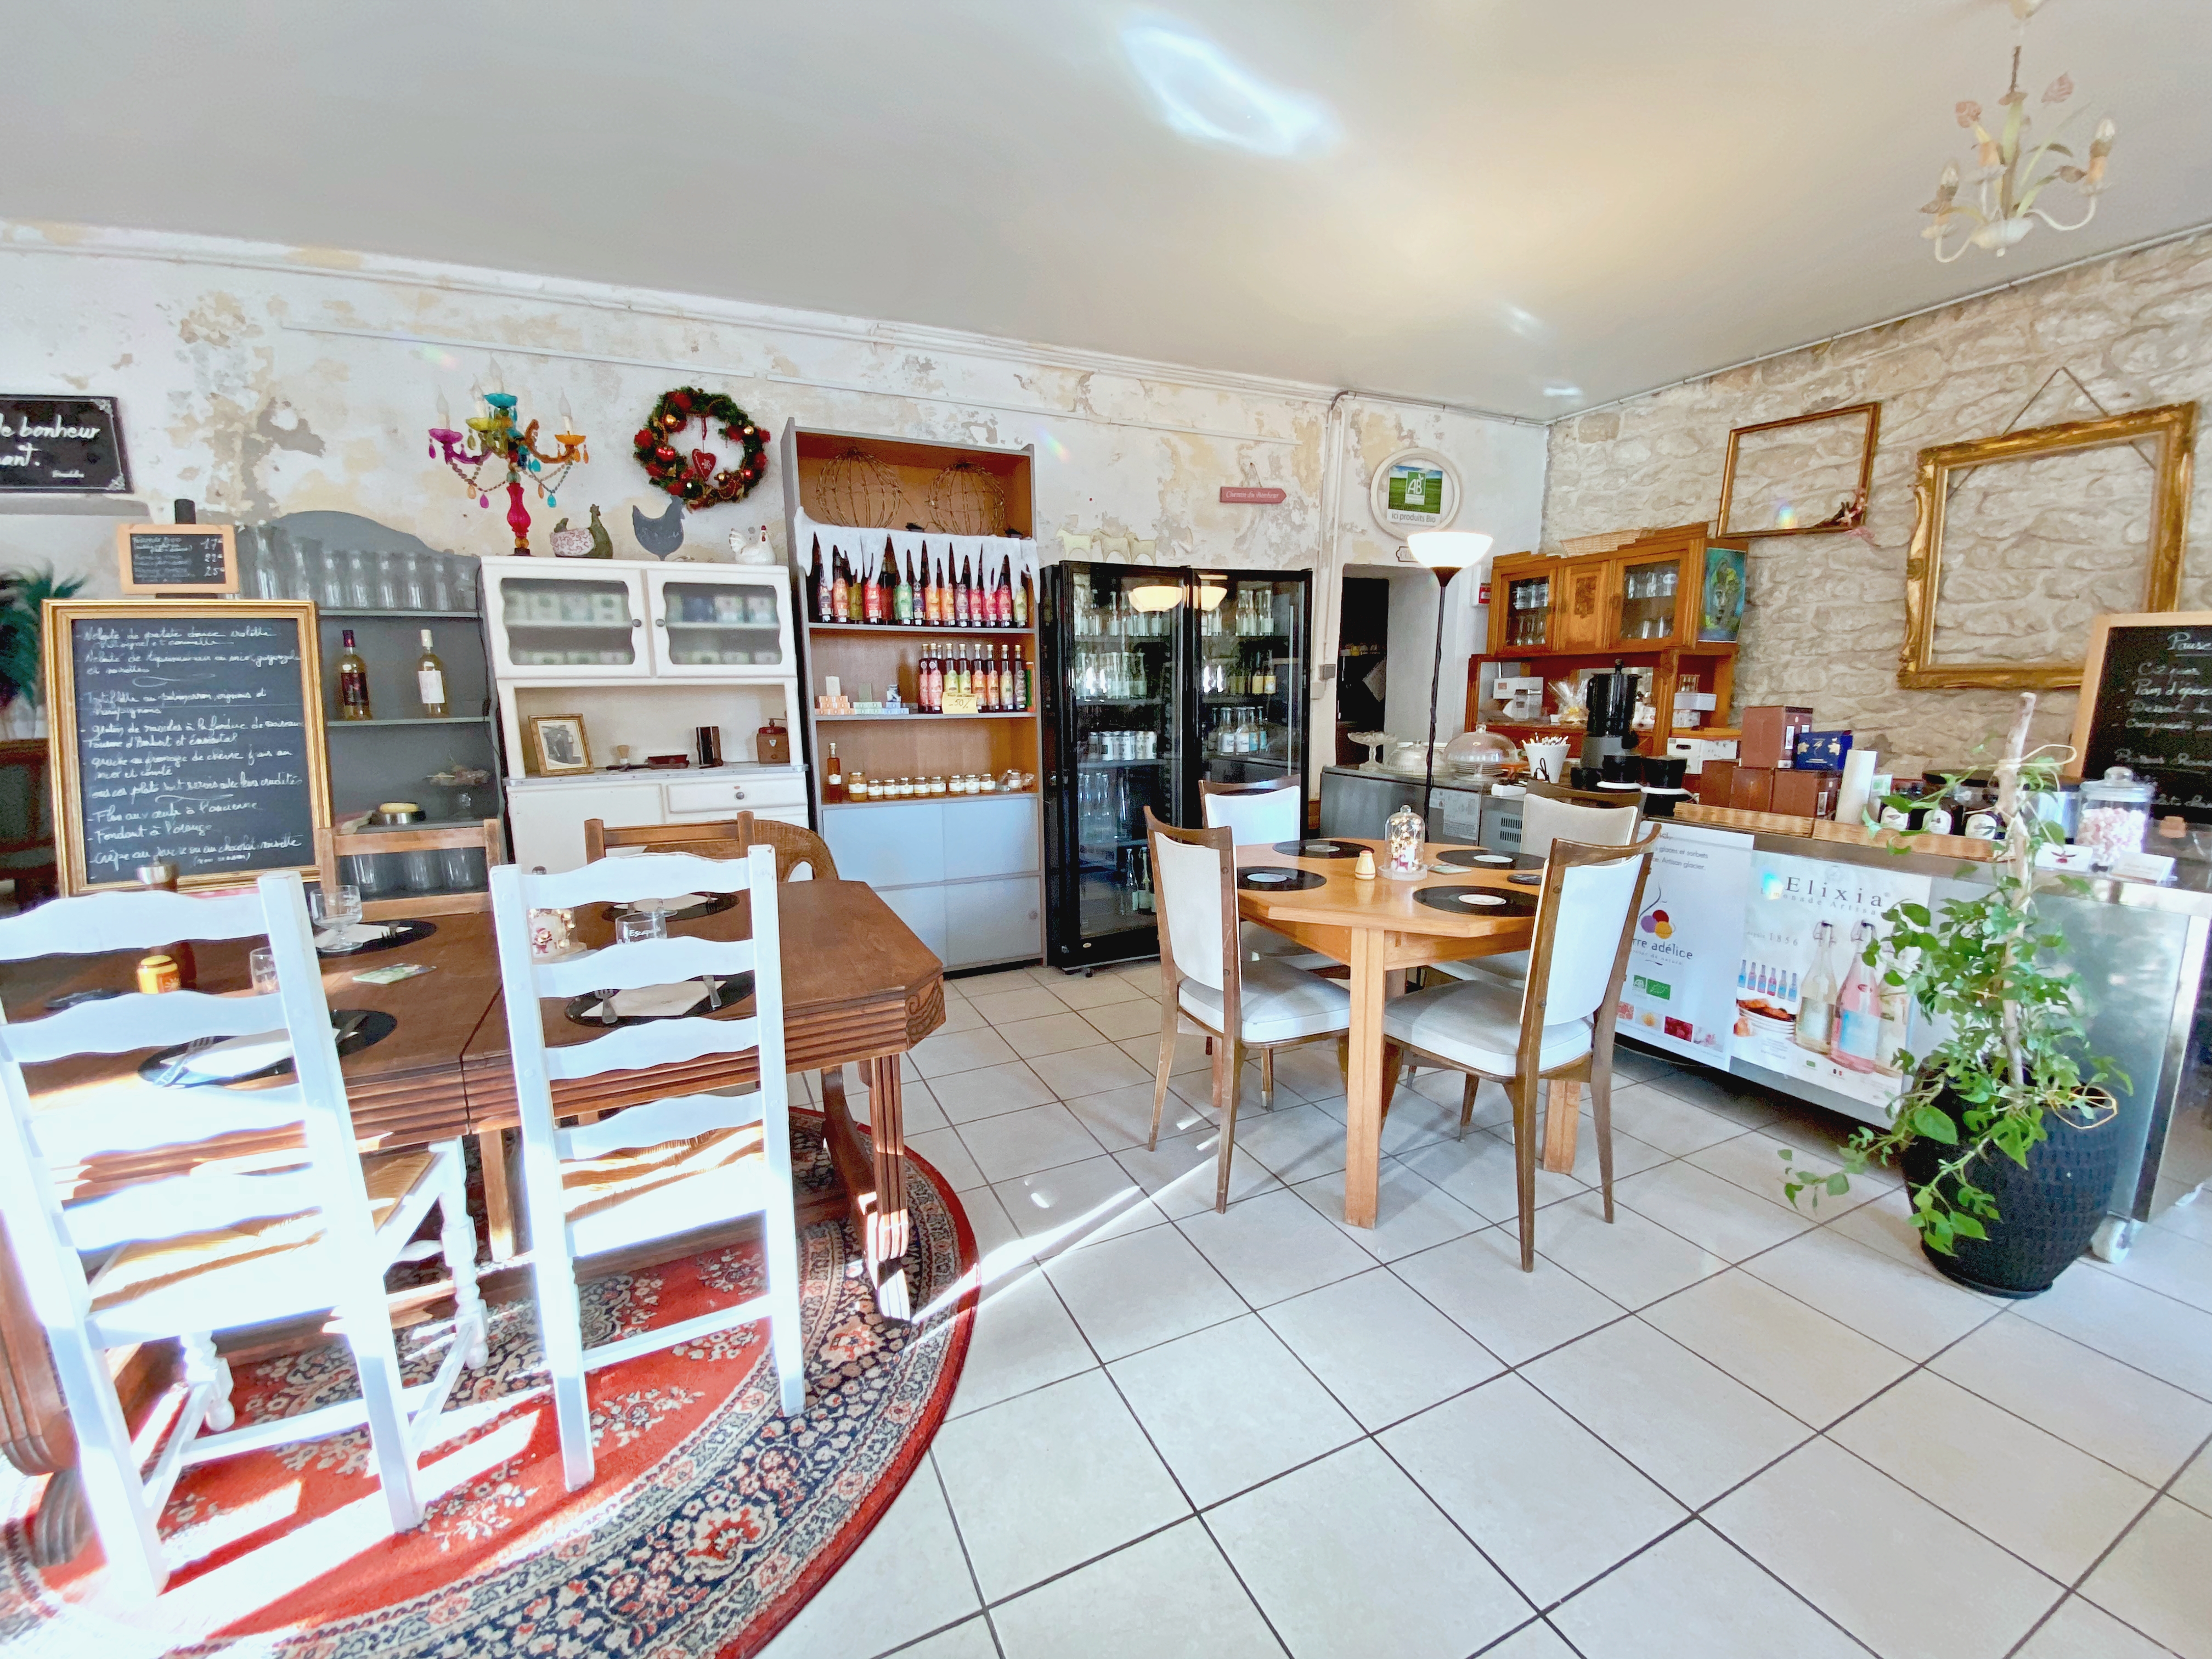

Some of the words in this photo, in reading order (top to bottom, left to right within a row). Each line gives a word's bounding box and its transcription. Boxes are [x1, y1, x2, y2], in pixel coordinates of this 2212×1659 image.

[19, 415, 102, 439] bonheur
[0, 442, 43, 466] ant.
[1407, 479, 1422, 494] AB
[1400, 514, 1424, 522] produits
[127, 723, 140, 733] de
[176, 735, 187, 746] et
[192, 750, 204, 761] de
[261, 772, 302, 786] crudités
[92, 804, 123, 822] Flan
[186, 806, 195, 815] à
[94, 825, 148, 844] Fondant
[150, 826, 162, 836] à
[1659, 846, 1678, 854] glaces
[1687, 850, 1708, 859] sorbets
[92, 849, 130, 871] Crêpe
[1662, 857, 1682, 866] Artisan
[1770, 933, 1798, 946] 1856
[1633, 938, 1647, 948] rre
[1651, 941, 1693, 960] adélice
